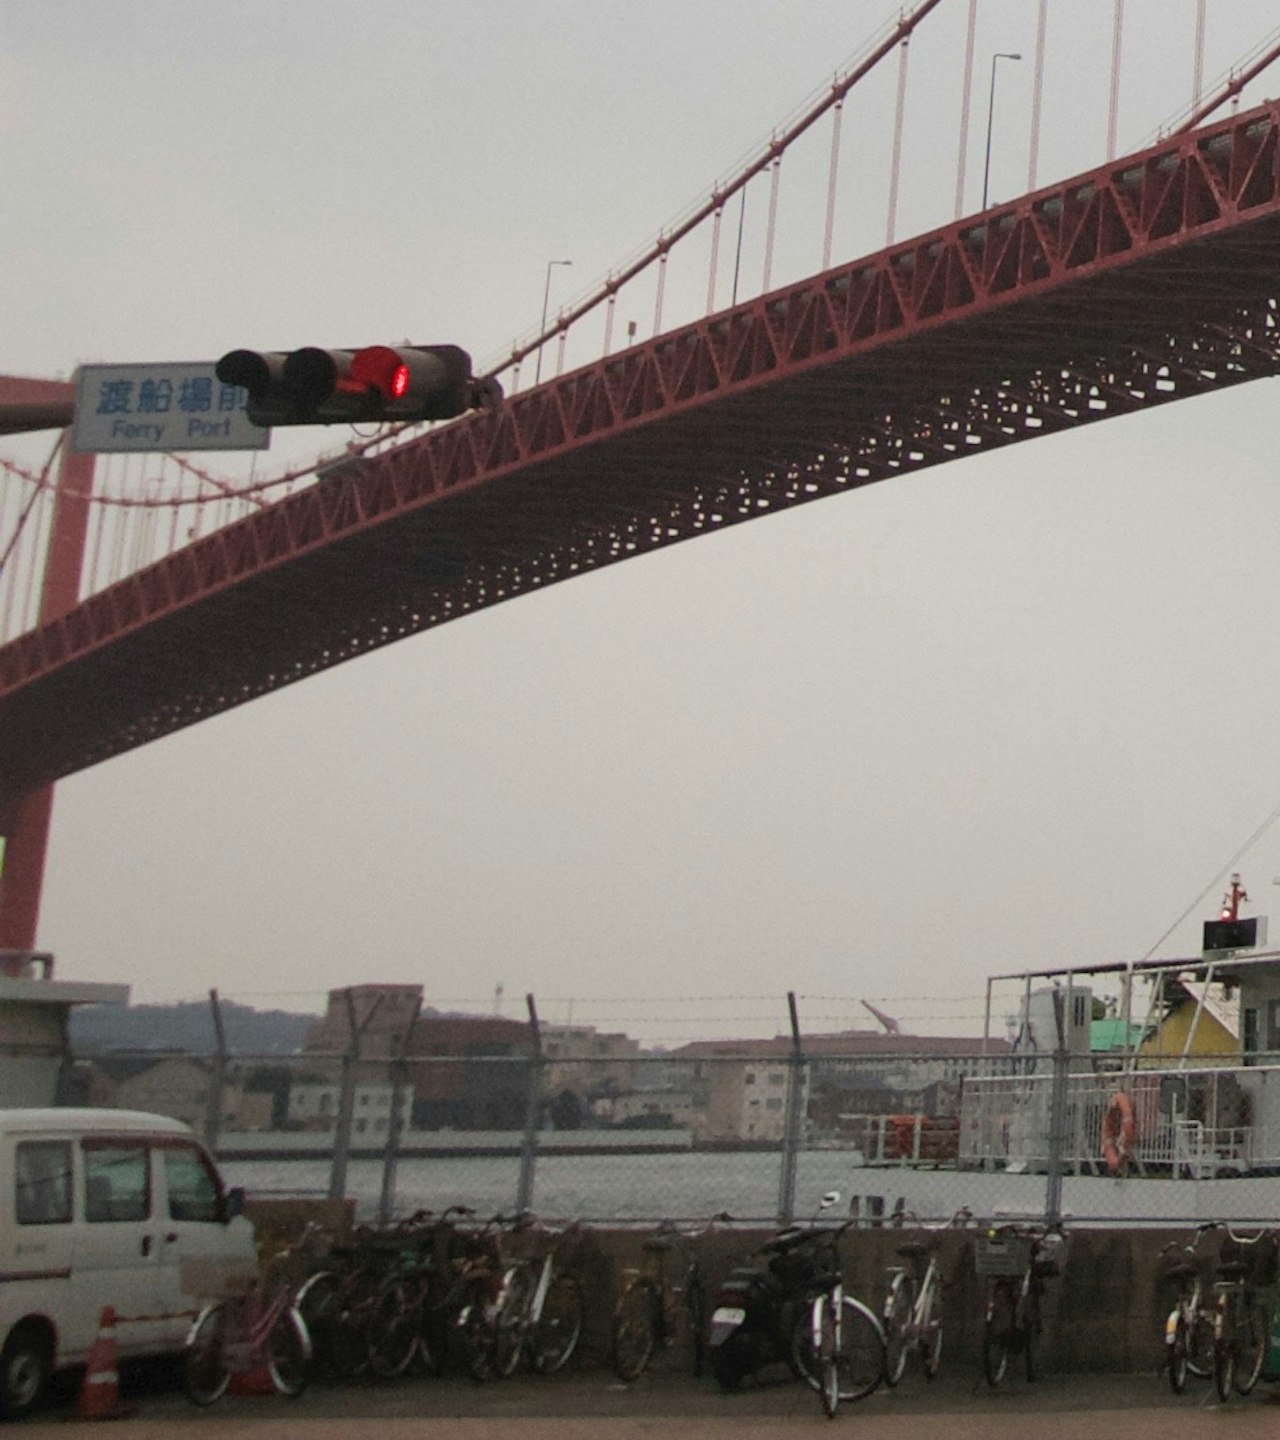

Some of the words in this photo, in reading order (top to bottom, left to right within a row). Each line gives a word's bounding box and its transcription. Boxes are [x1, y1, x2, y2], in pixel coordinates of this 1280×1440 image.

[96, 376, 249, 415] 渡船場前
[112, 419, 165, 442] Ferry
[188, 418, 230, 437] Port
